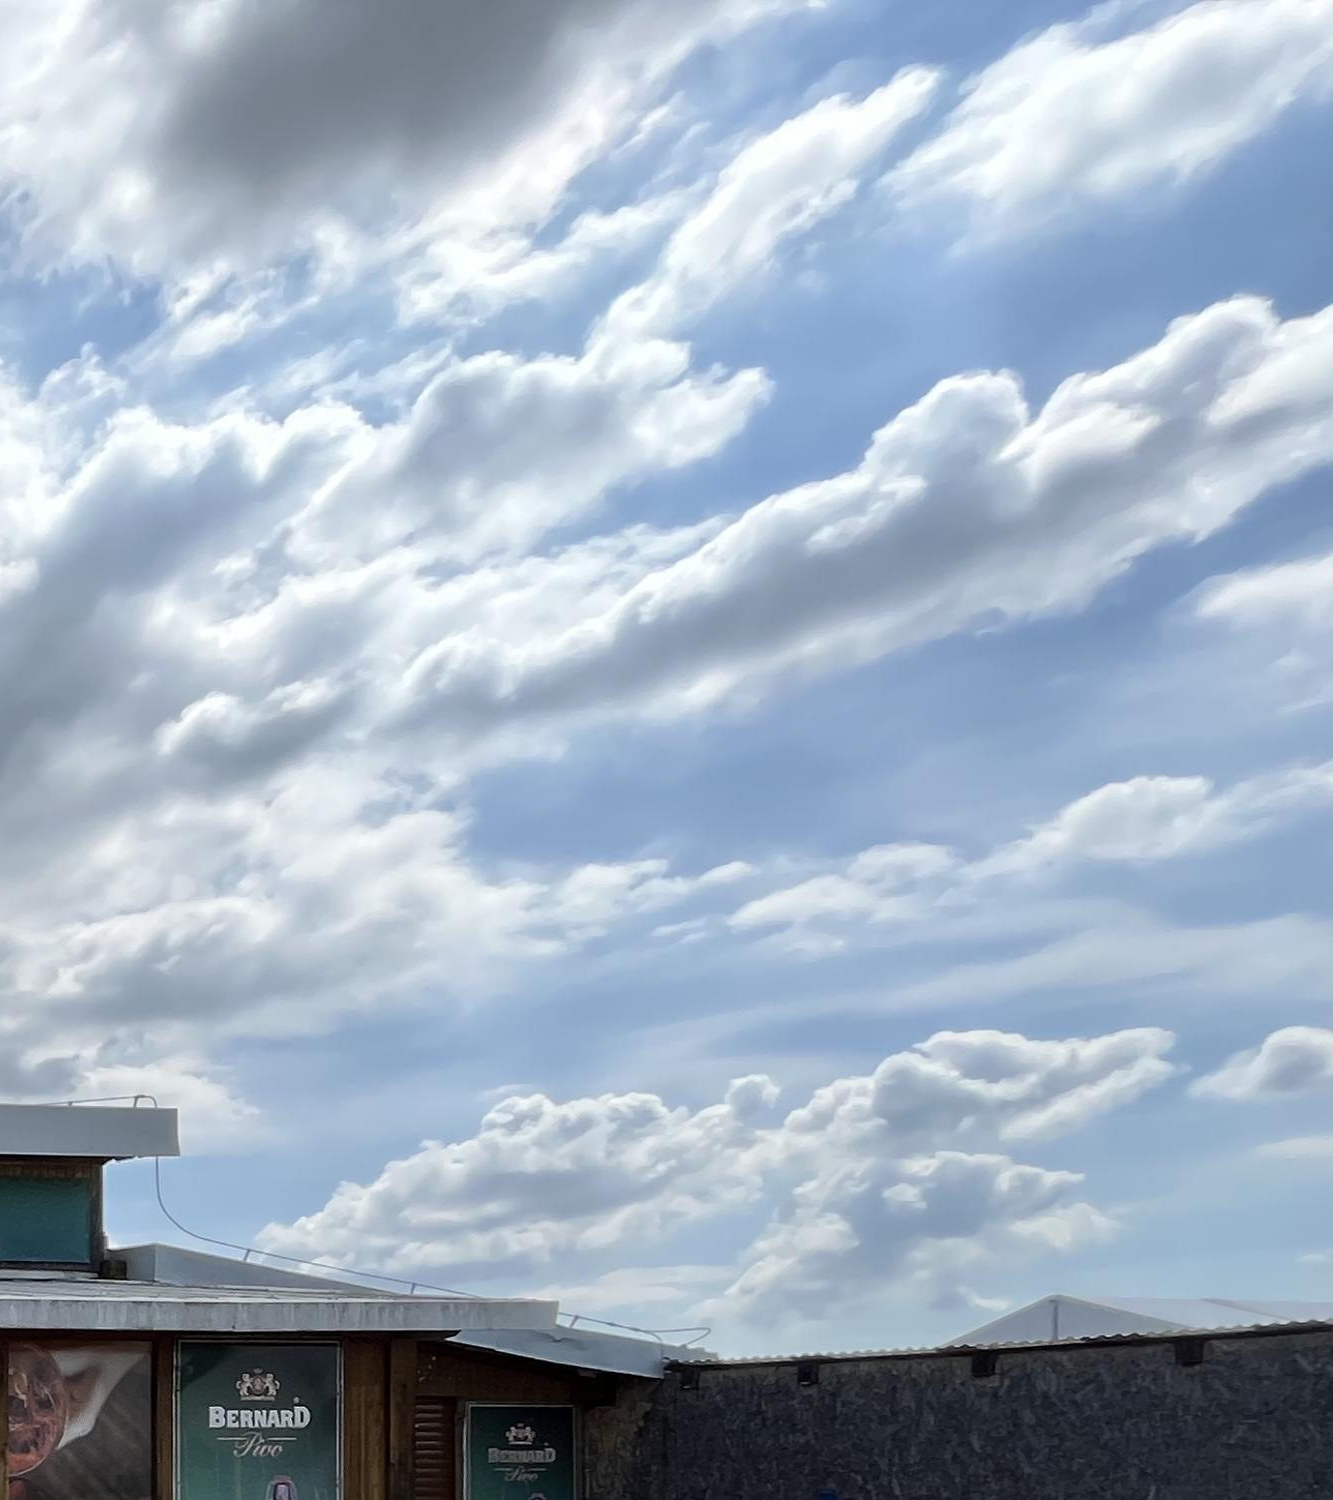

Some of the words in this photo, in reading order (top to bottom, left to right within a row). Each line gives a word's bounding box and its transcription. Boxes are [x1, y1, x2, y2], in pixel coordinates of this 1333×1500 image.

[208, 1404, 311, 1429] BERNARD
[233, 1431, 283, 1458] Pivo
[488, 1447, 557, 1463] BERNARD
